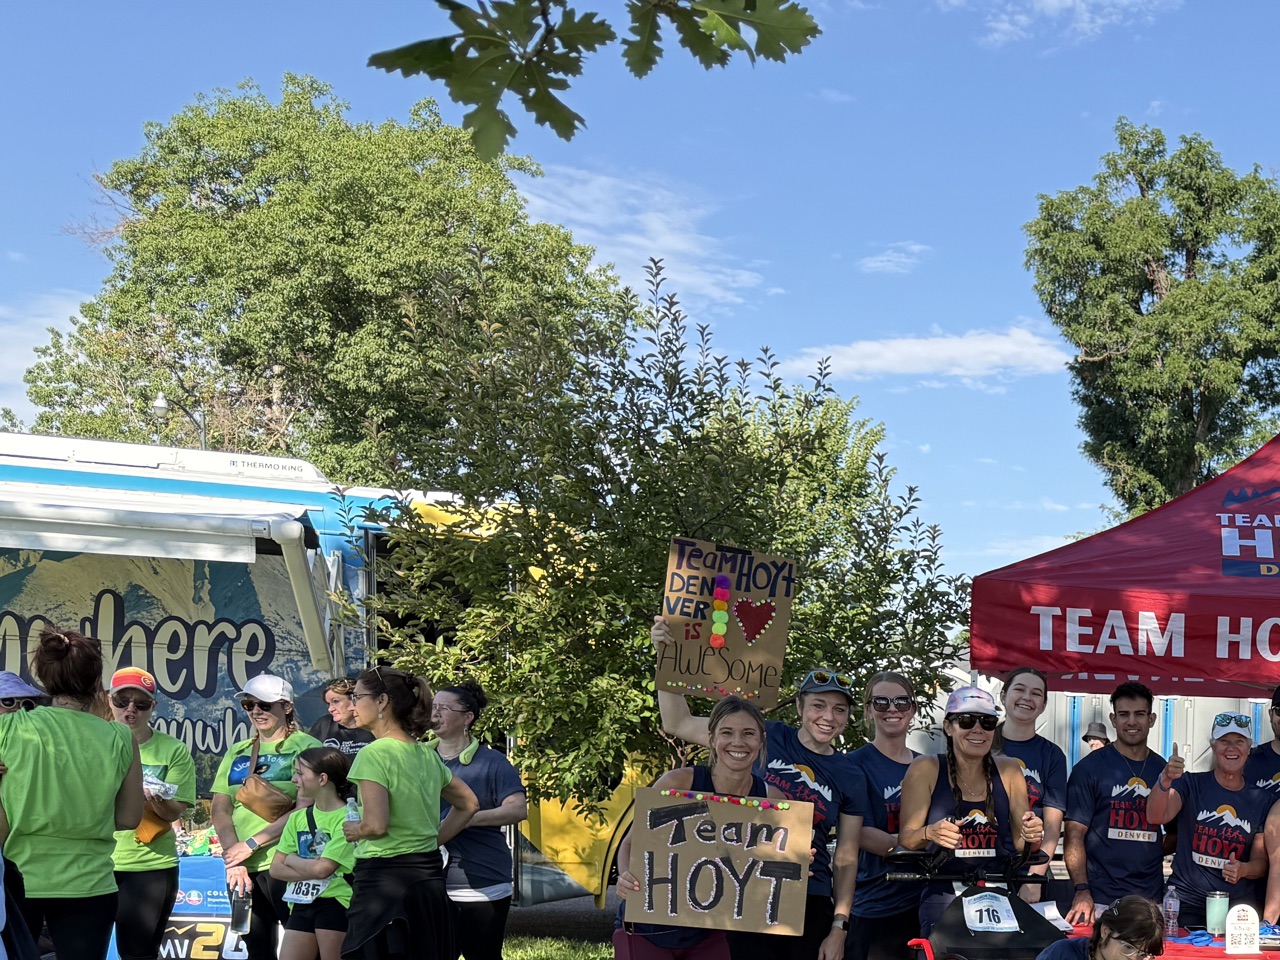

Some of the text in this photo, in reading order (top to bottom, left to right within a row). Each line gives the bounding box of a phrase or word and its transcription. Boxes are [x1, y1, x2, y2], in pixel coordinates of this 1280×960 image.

[241, 461, 280, 470] THERMO
[669, 572, 716, 597] DEN
[665, 595, 710, 620] VER
[1030, 605, 1186, 658] TEAM
[764, 772, 791, 790] TEAM
[1110, 801, 1132, 809] TEAM
[647, 800, 789, 853] Team
[1109, 809, 1157, 831] HOY
[1117, 831, 1152, 840] DENVER
[1195, 823, 1218, 836] TEAM
[1192, 832, 1245, 861] HOYT
[1198, 856, 1227, 867] DENV
[291, 881, 321, 897] 1835
[643, 850, 802, 926] HOYT
[975, 907, 1001, 924] 716
